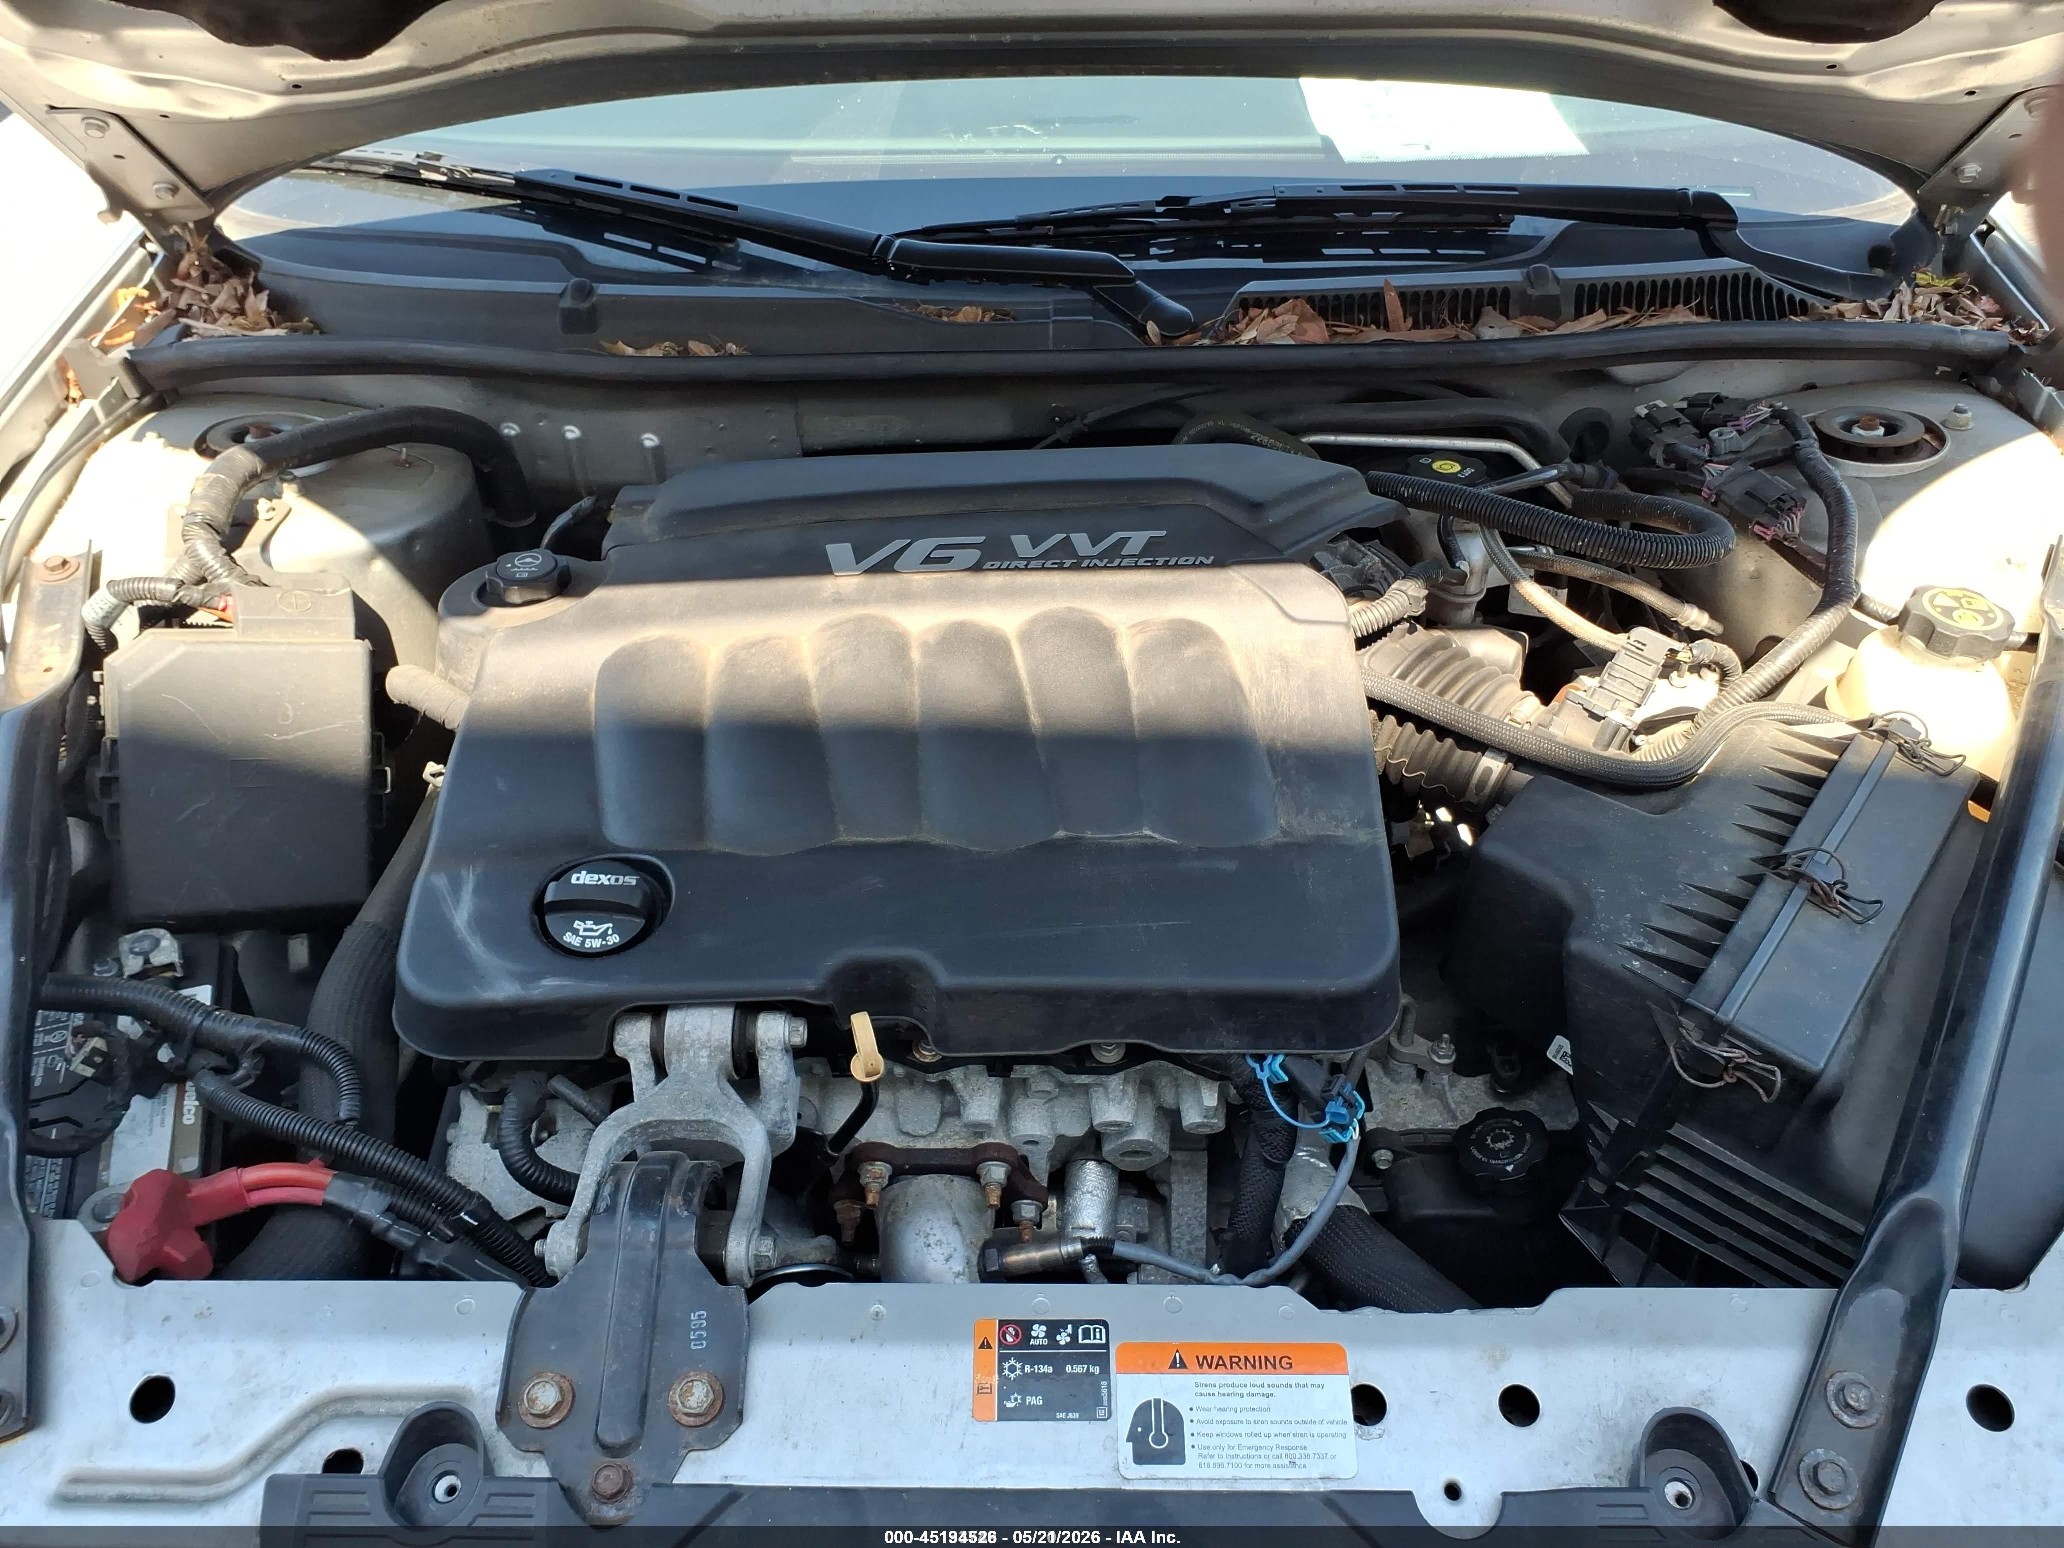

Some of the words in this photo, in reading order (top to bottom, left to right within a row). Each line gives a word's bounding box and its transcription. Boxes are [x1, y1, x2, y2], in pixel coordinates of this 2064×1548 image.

[825, 536, 986, 576] V6
[1009, 530, 1167, 558] VVT
[982, 560, 1078, 570] DIRECT
[1081, 556, 1215, 567] INJECTION
[570, 870, 640, 886] dexos
[563, 932, 583, 947] SAE
[584, 934, 620, 948] 5W-30
[690, 1310, 707, 1350] 0595
[1029, 1338, 1048, 1346] AUTO
[1024, 1364, 1053, 1373] R-134a
[1065, 1365, 1087, 1373] 0.567
[1089, 1364, 1100, 1375] kg
[1195, 1355, 1293, 1370] WARNING
[1026, 1396, 1043, 1405] PAG
